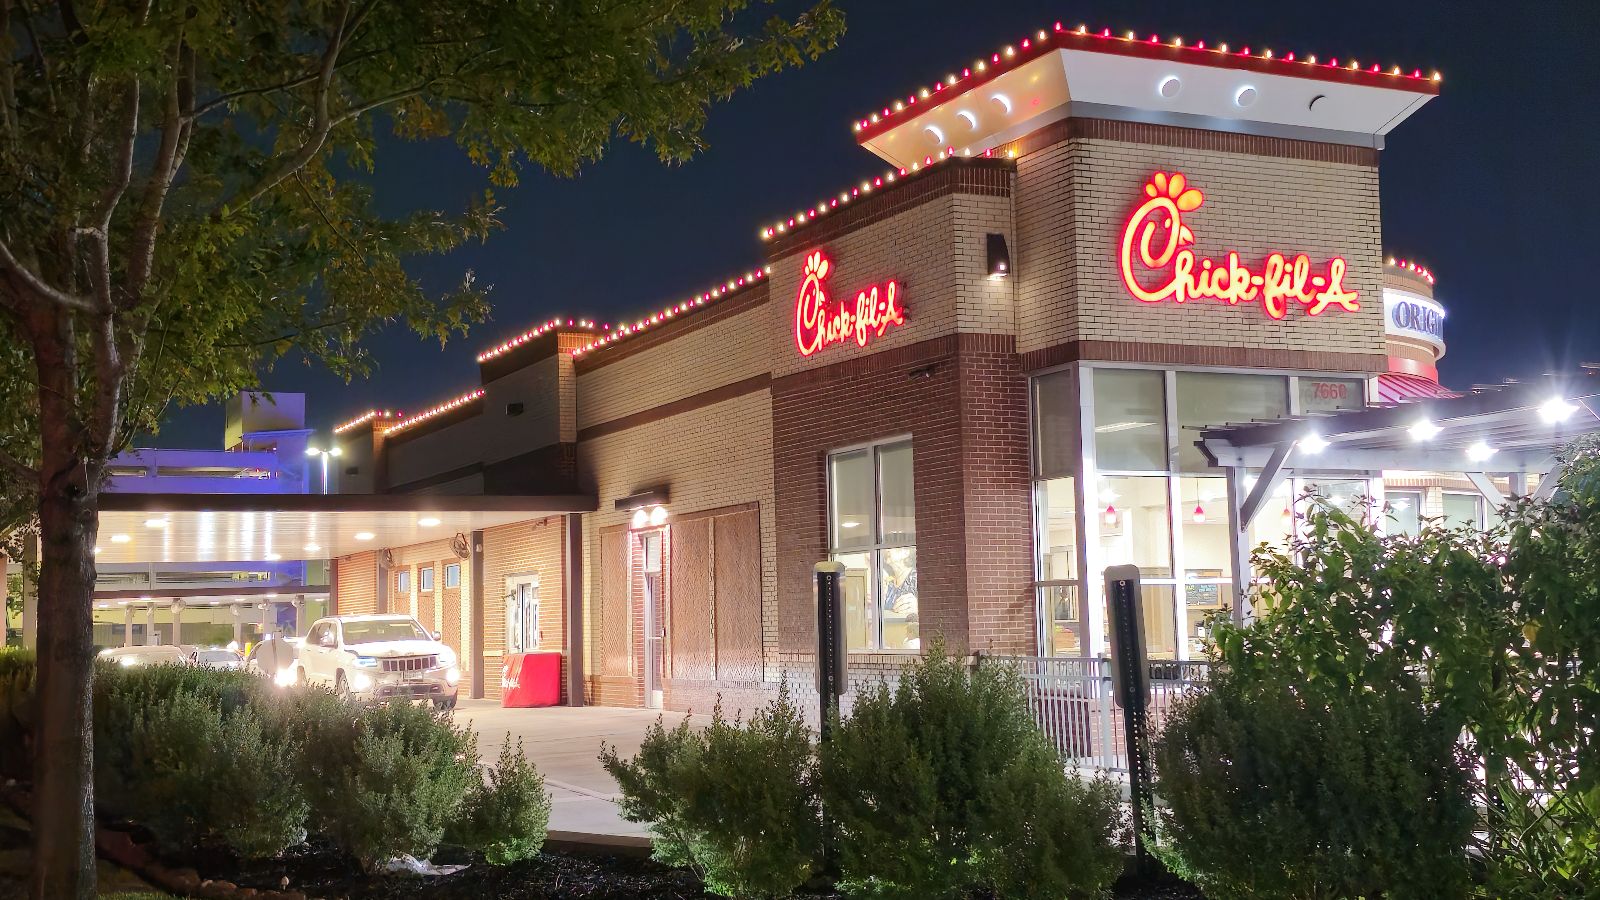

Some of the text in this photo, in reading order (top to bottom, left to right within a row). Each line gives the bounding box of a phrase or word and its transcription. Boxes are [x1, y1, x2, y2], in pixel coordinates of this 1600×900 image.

[1121, 190, 1360, 320] Chick-fil-A
[797, 264, 904, 356] Chick-fil-A
[1312, 382, 1347, 400] 7660
